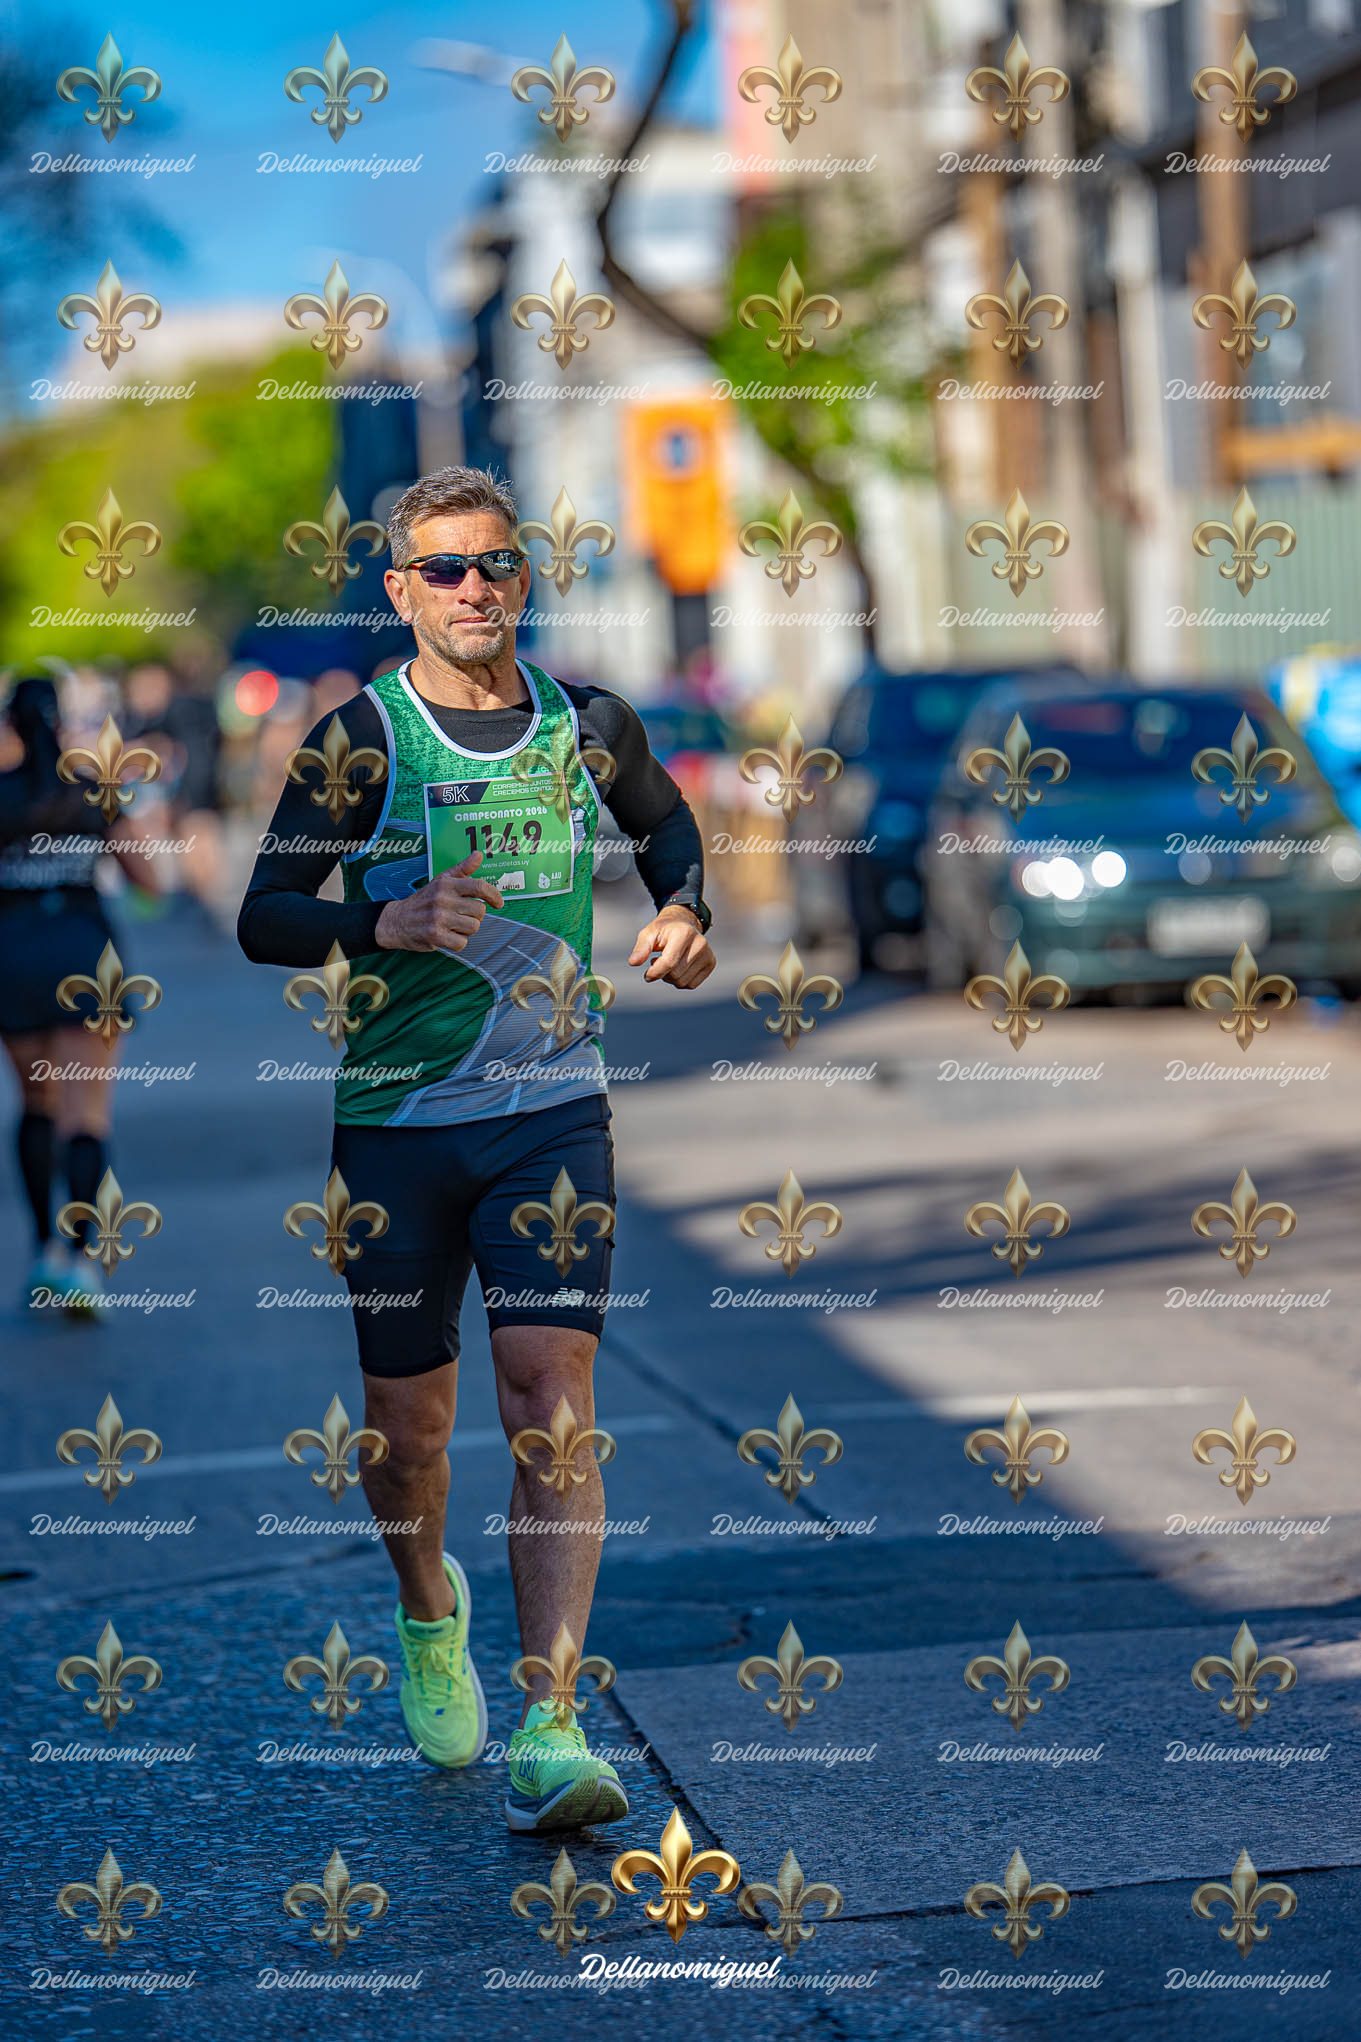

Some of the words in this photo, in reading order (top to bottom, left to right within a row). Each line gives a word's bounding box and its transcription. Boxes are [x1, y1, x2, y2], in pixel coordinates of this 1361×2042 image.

[442, 785, 471, 804] 5K
[493, 787, 530, 796] CRECEMOS
[454, 809, 523, 822] CAMPEONATO
[465, 820, 542, 859] 1149
